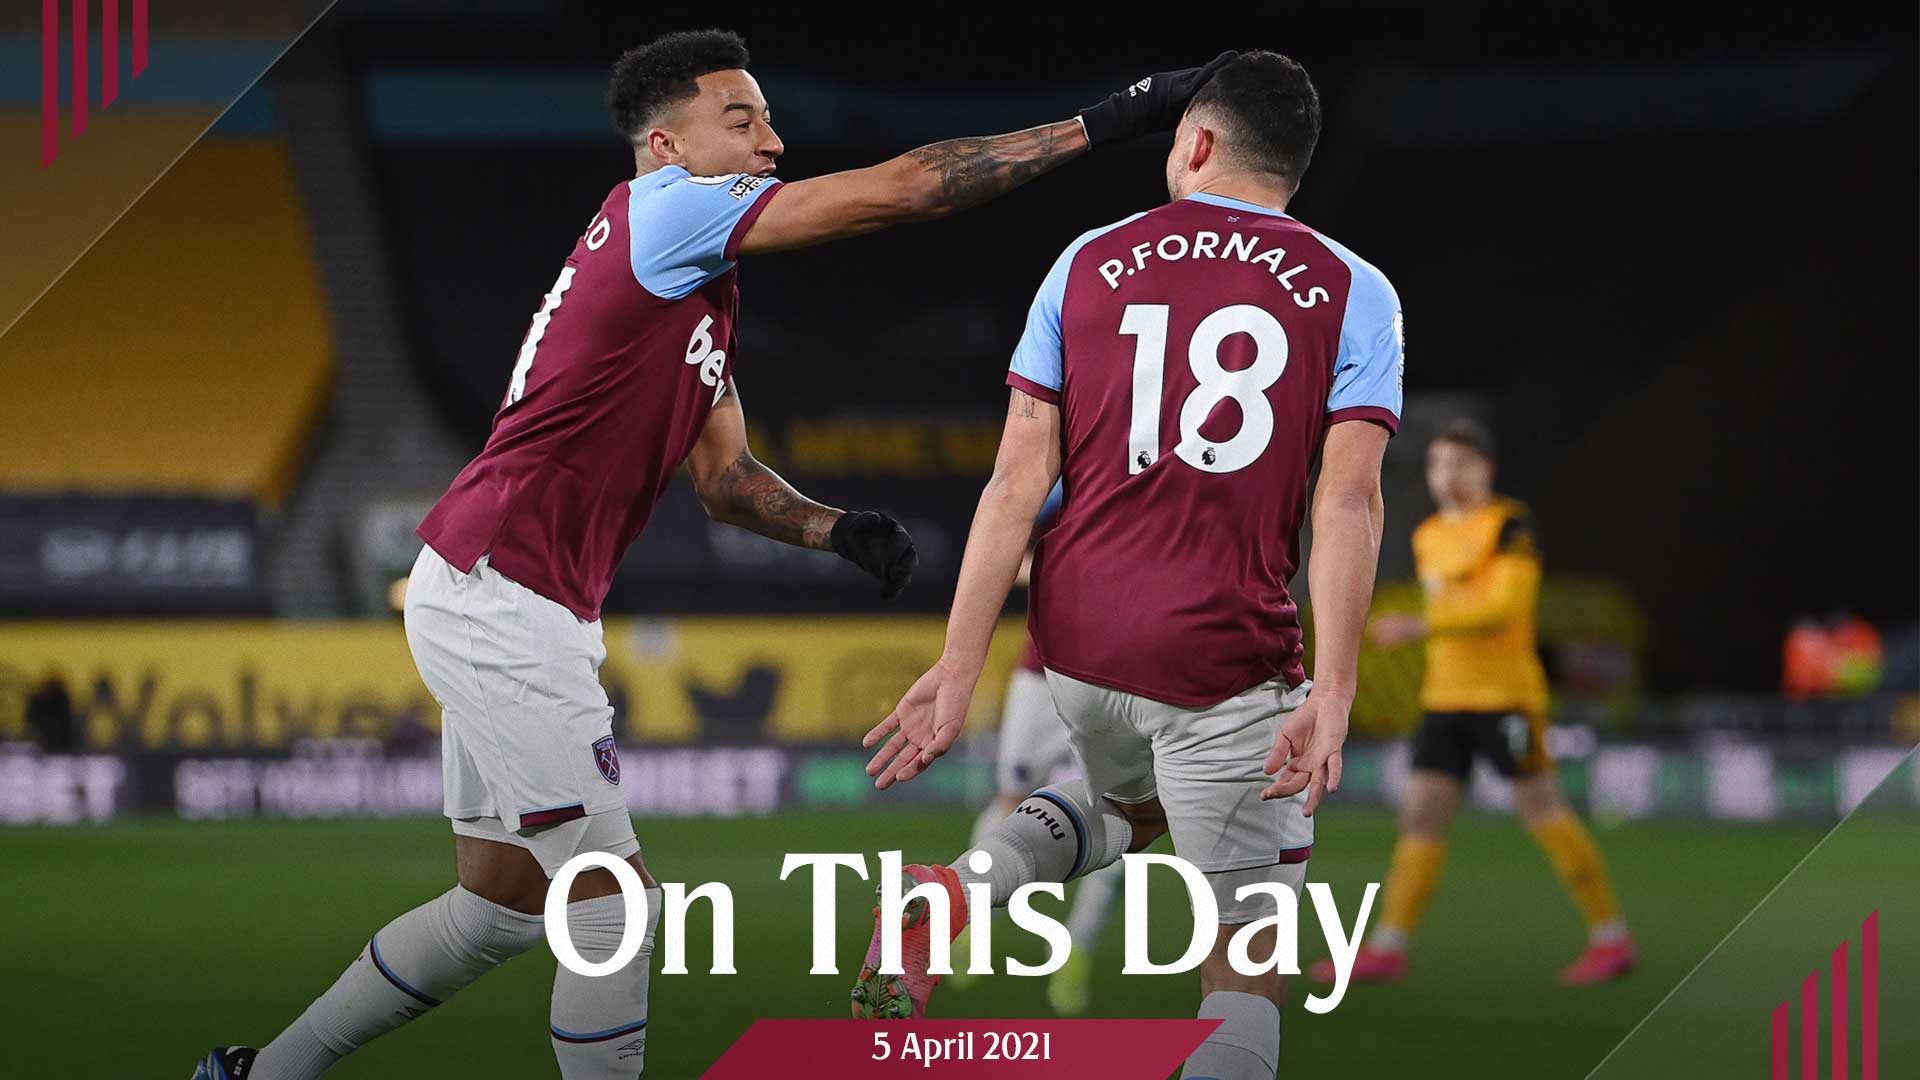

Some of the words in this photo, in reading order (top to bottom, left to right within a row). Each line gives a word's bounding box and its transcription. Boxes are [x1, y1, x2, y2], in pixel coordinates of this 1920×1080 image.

[1099, 231, 1330, 309] P.FORNALS
[1118, 304, 1289, 475] 18
[1016, 805, 1066, 841] WHU
